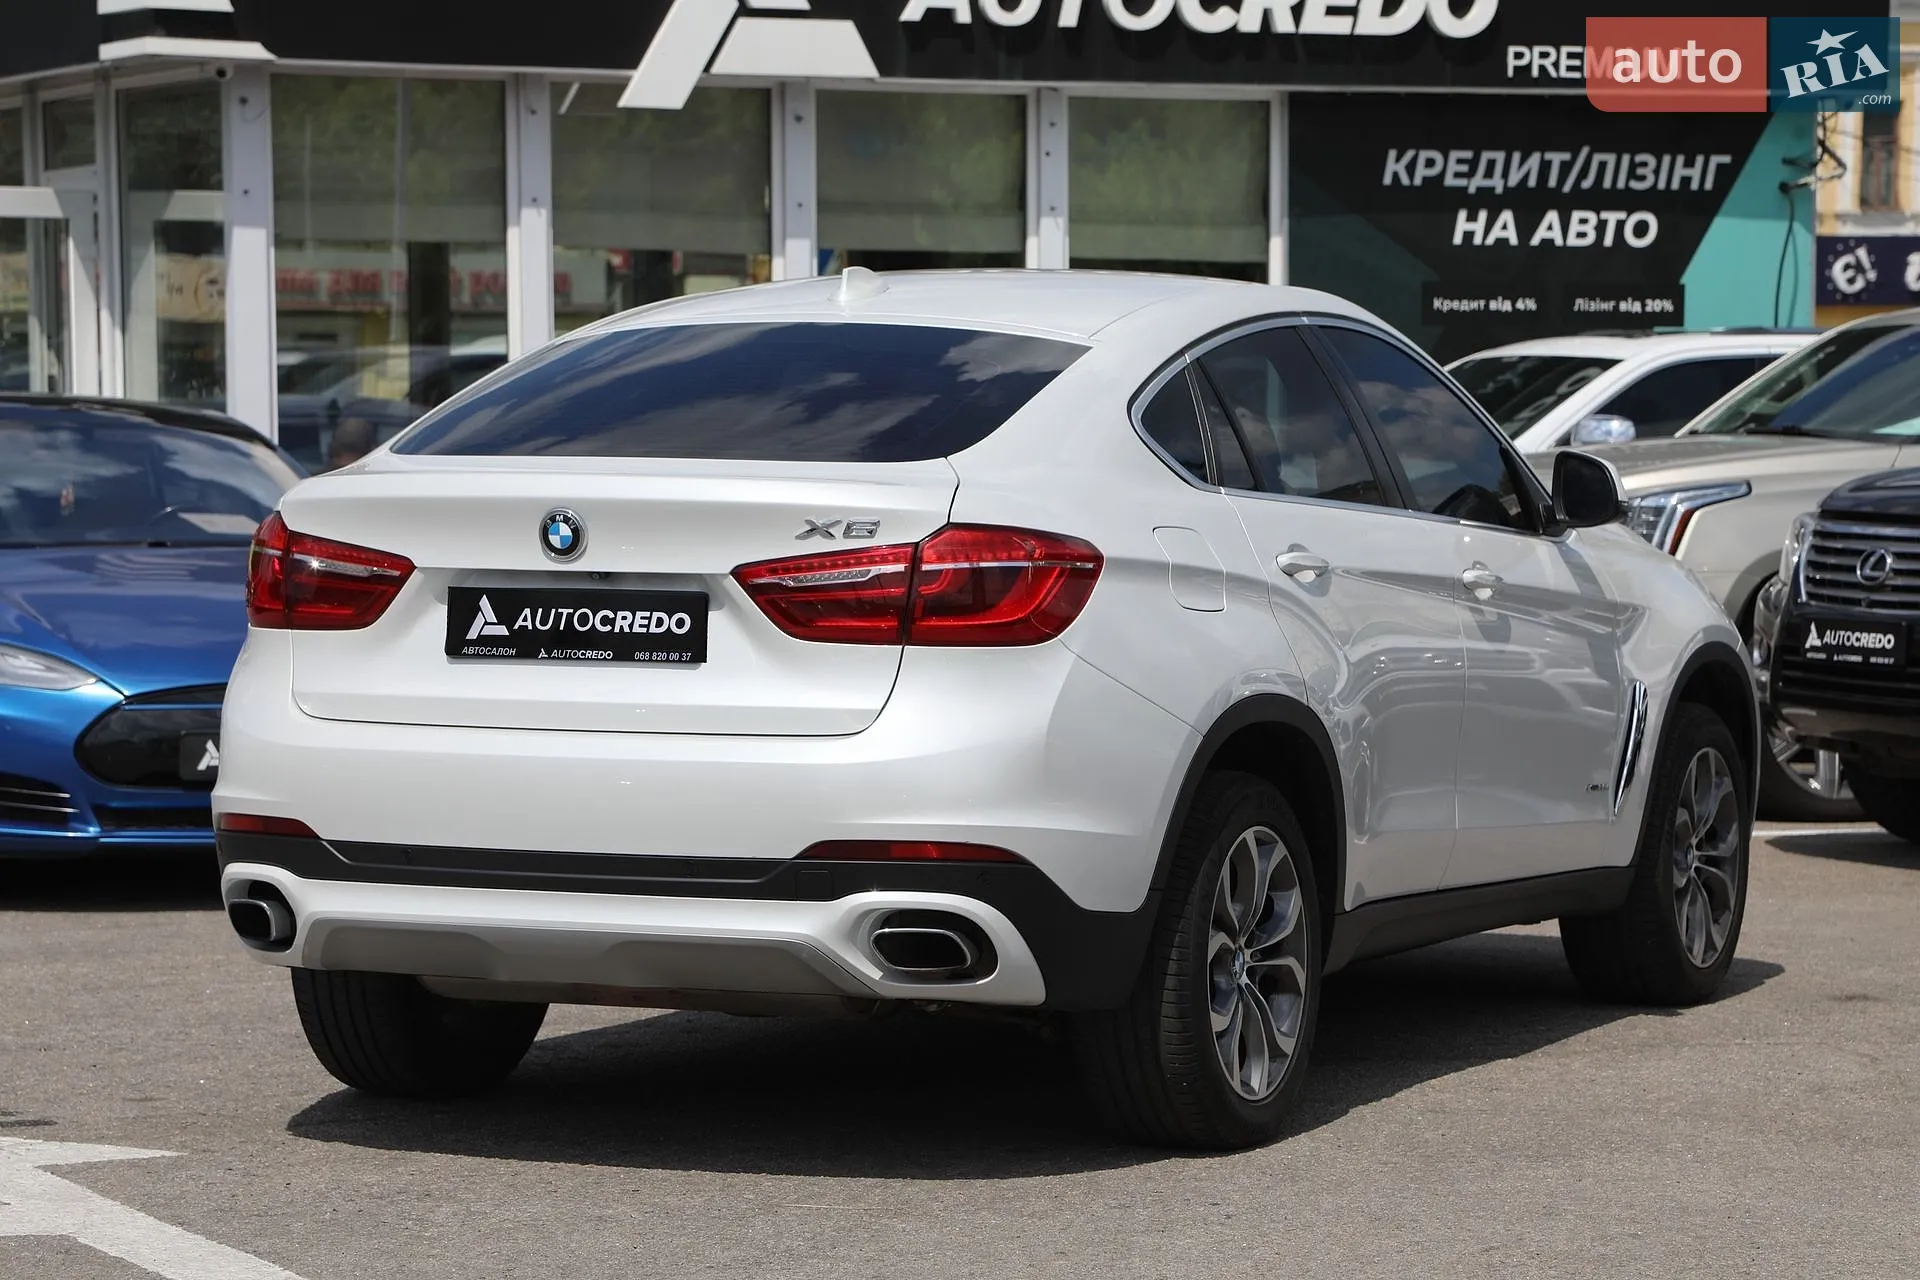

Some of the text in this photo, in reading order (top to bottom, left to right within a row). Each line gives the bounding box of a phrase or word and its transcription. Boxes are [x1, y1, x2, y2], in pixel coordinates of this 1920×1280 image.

[1506, 45, 1682, 79] PREMM
[1382, 147, 1732, 194] КРЕДИТ/ЛІЗІНГ
[1452, 209, 1658, 248] НА АВТО
[1433, 296, 1538, 313] Кредит від 4%
[1573, 297, 1674, 313] Лізінг від 20%
[795, 519, 881, 540] X6
[513, 607, 691, 635] AUTOCREDO
[1823, 629, 1895, 650] AUTOCREDO
[462, 646, 516, 656] АВТОСАЛОН
[551, 649, 613, 660] AUTOCREDO
[634, 651, 692, 661] 068 820 00 37
